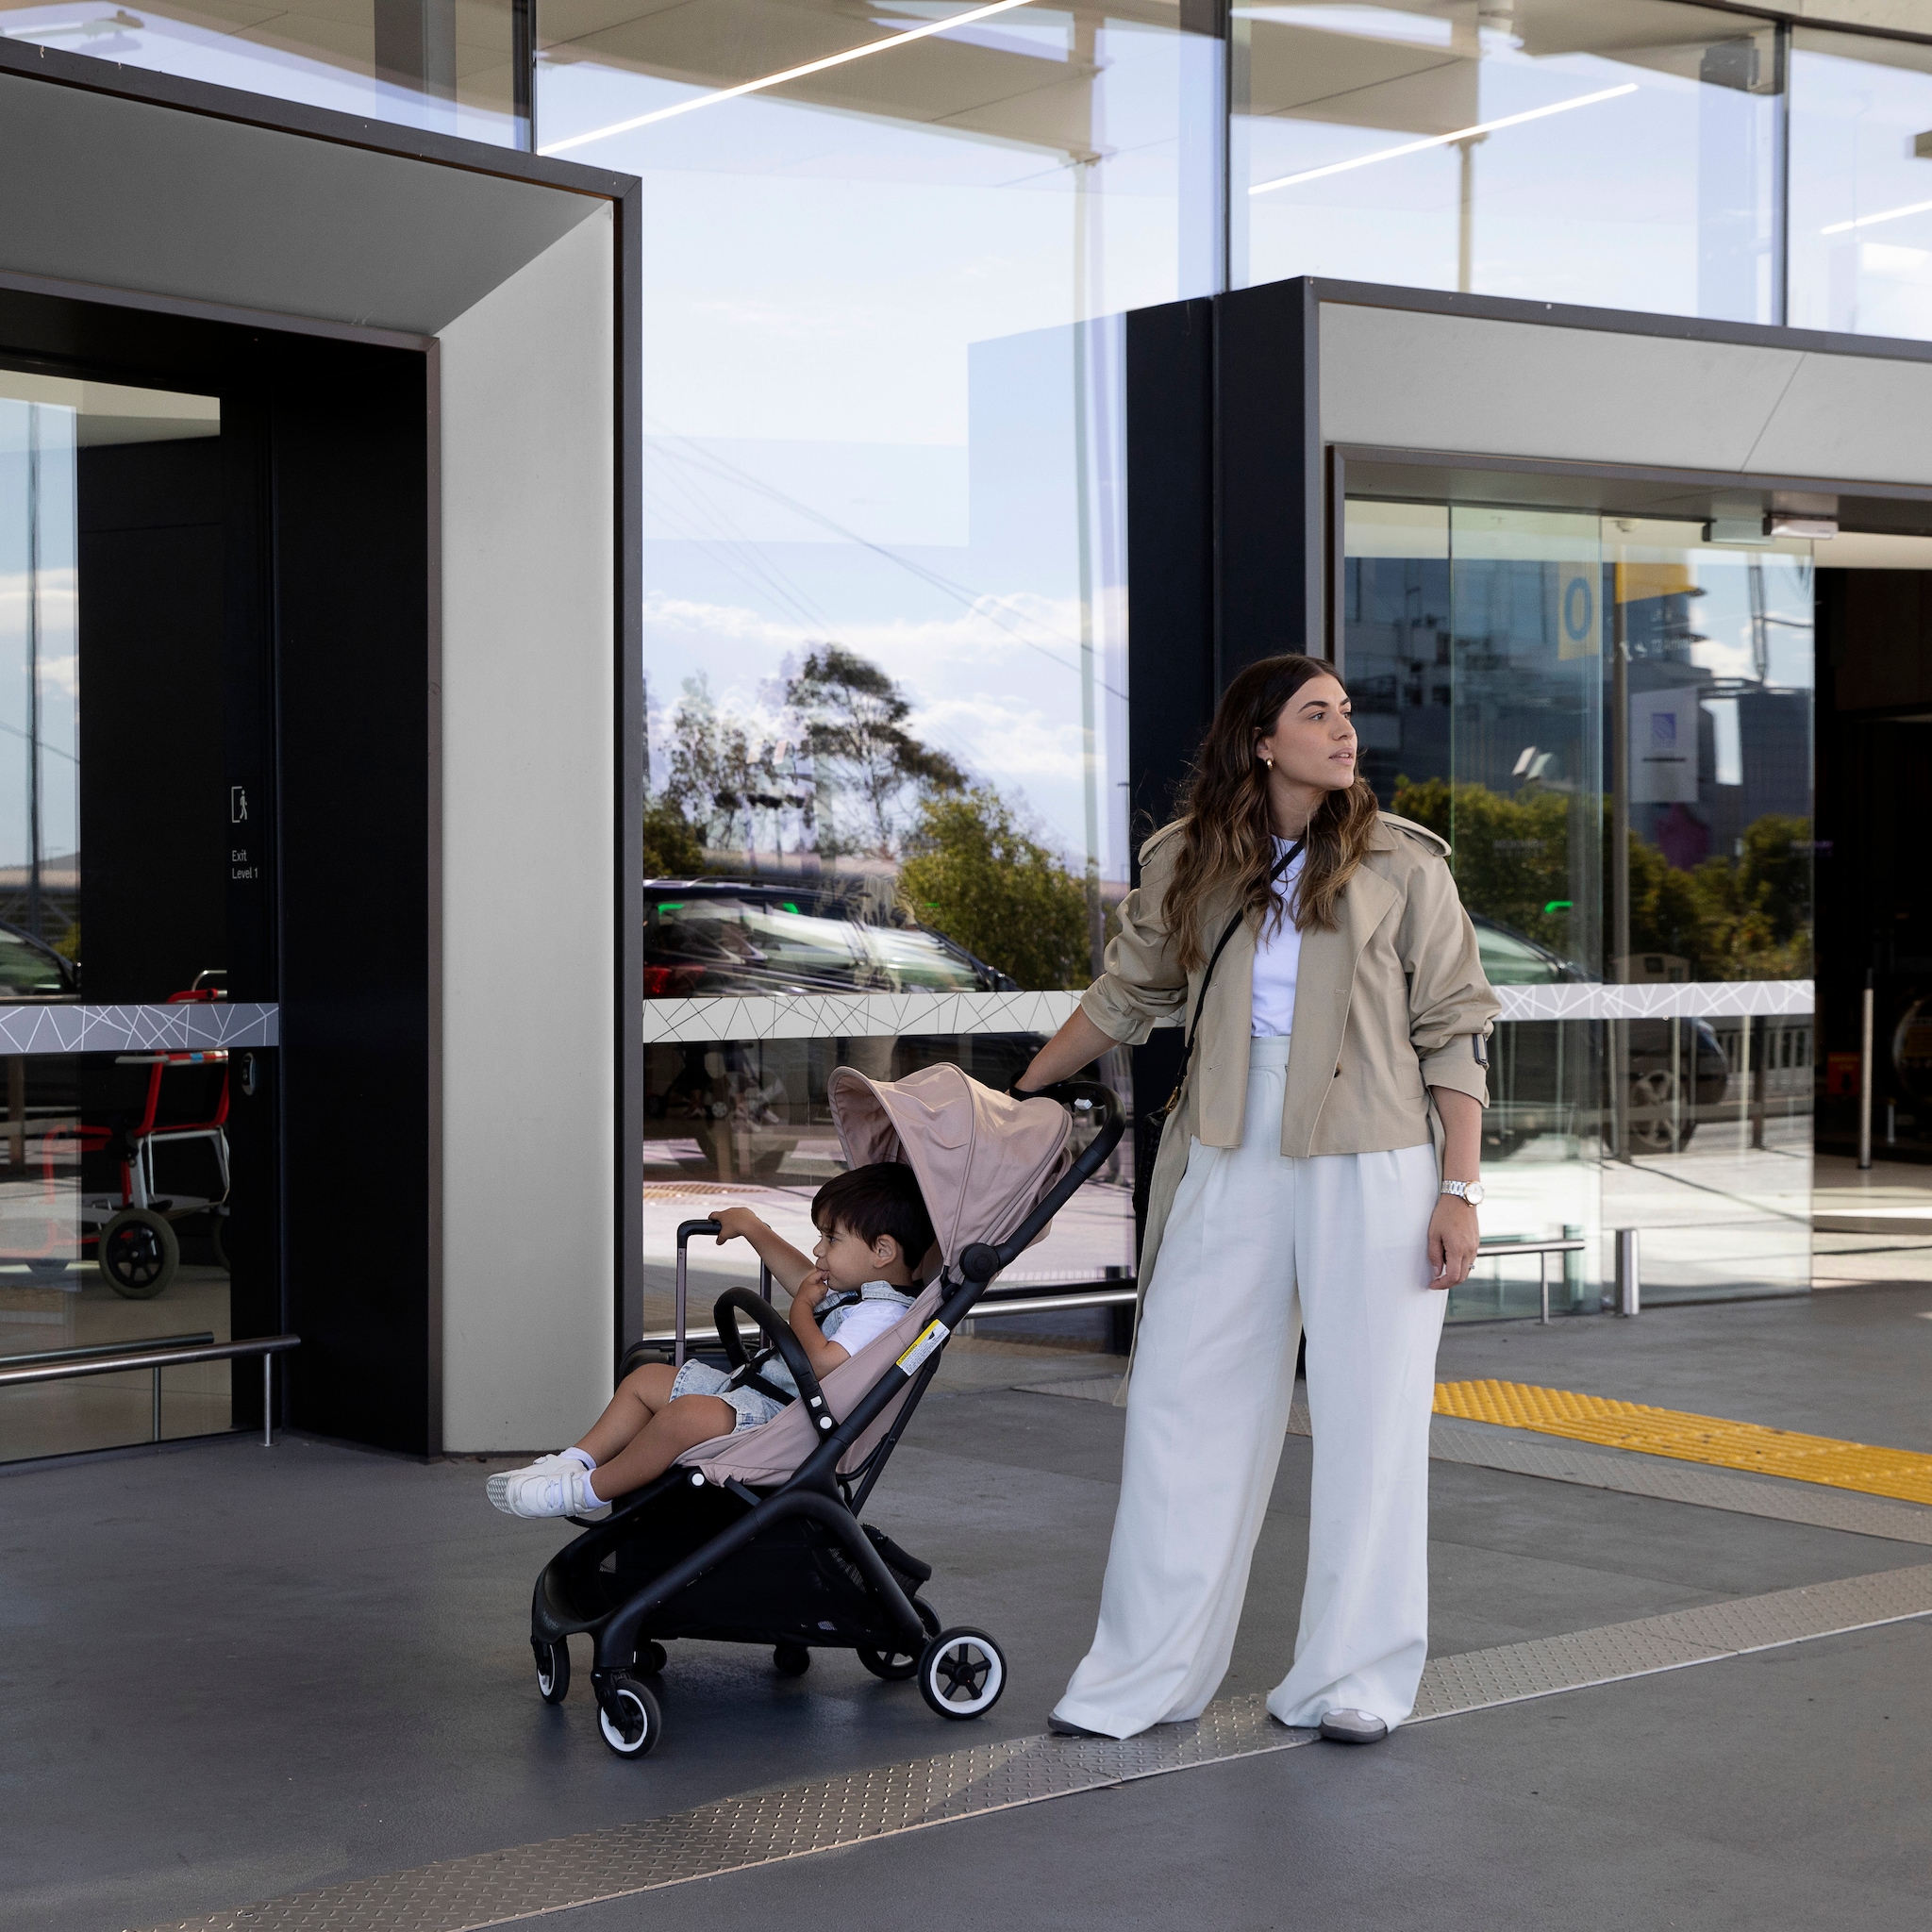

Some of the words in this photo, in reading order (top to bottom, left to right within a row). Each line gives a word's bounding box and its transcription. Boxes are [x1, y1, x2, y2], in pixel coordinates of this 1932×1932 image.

[232, 849, 247, 861] Exit
[232, 867, 253, 879] Level
[254, 867, 258, 878] 1
